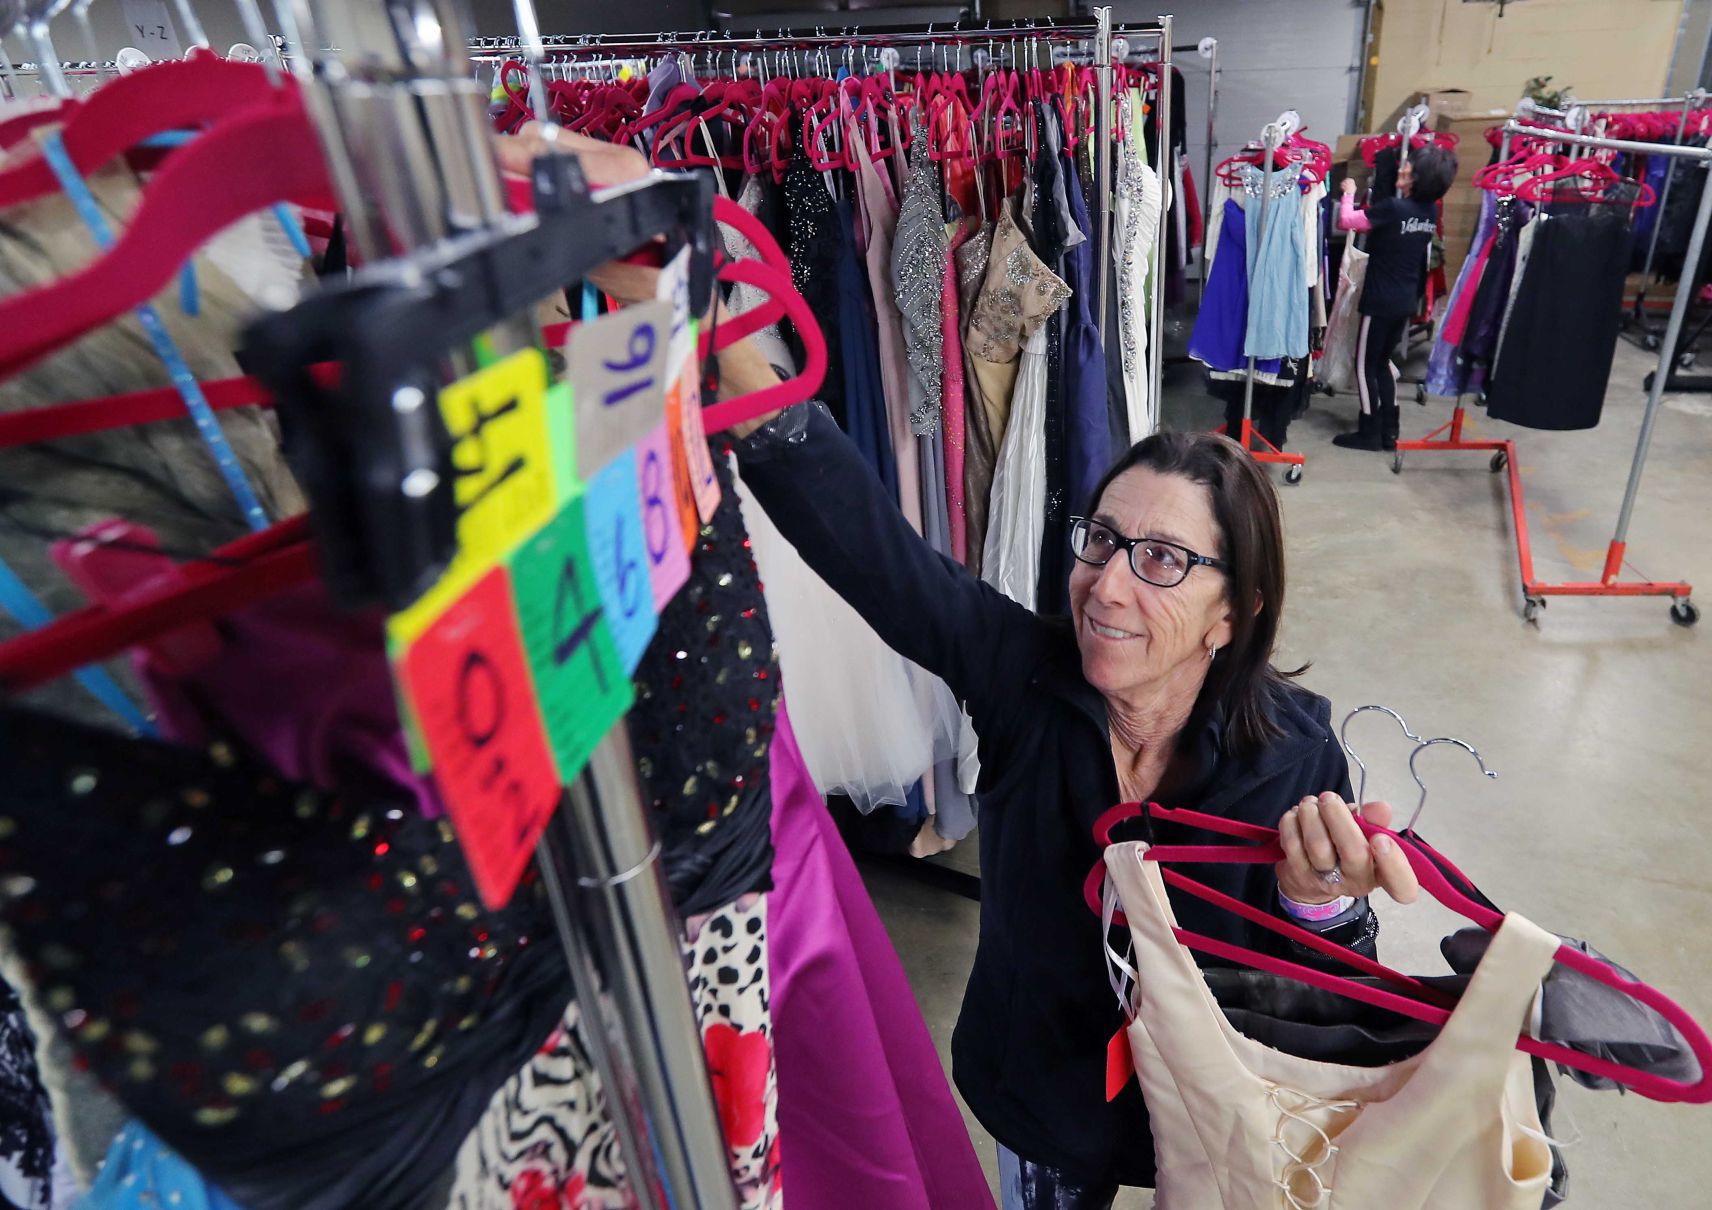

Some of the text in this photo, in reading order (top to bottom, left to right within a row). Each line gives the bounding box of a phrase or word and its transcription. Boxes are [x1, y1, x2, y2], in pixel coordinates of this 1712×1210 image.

[603, 321, 656, 407] 16
[642, 447, 669, 566] 8
[552, 554, 605, 695] 4
